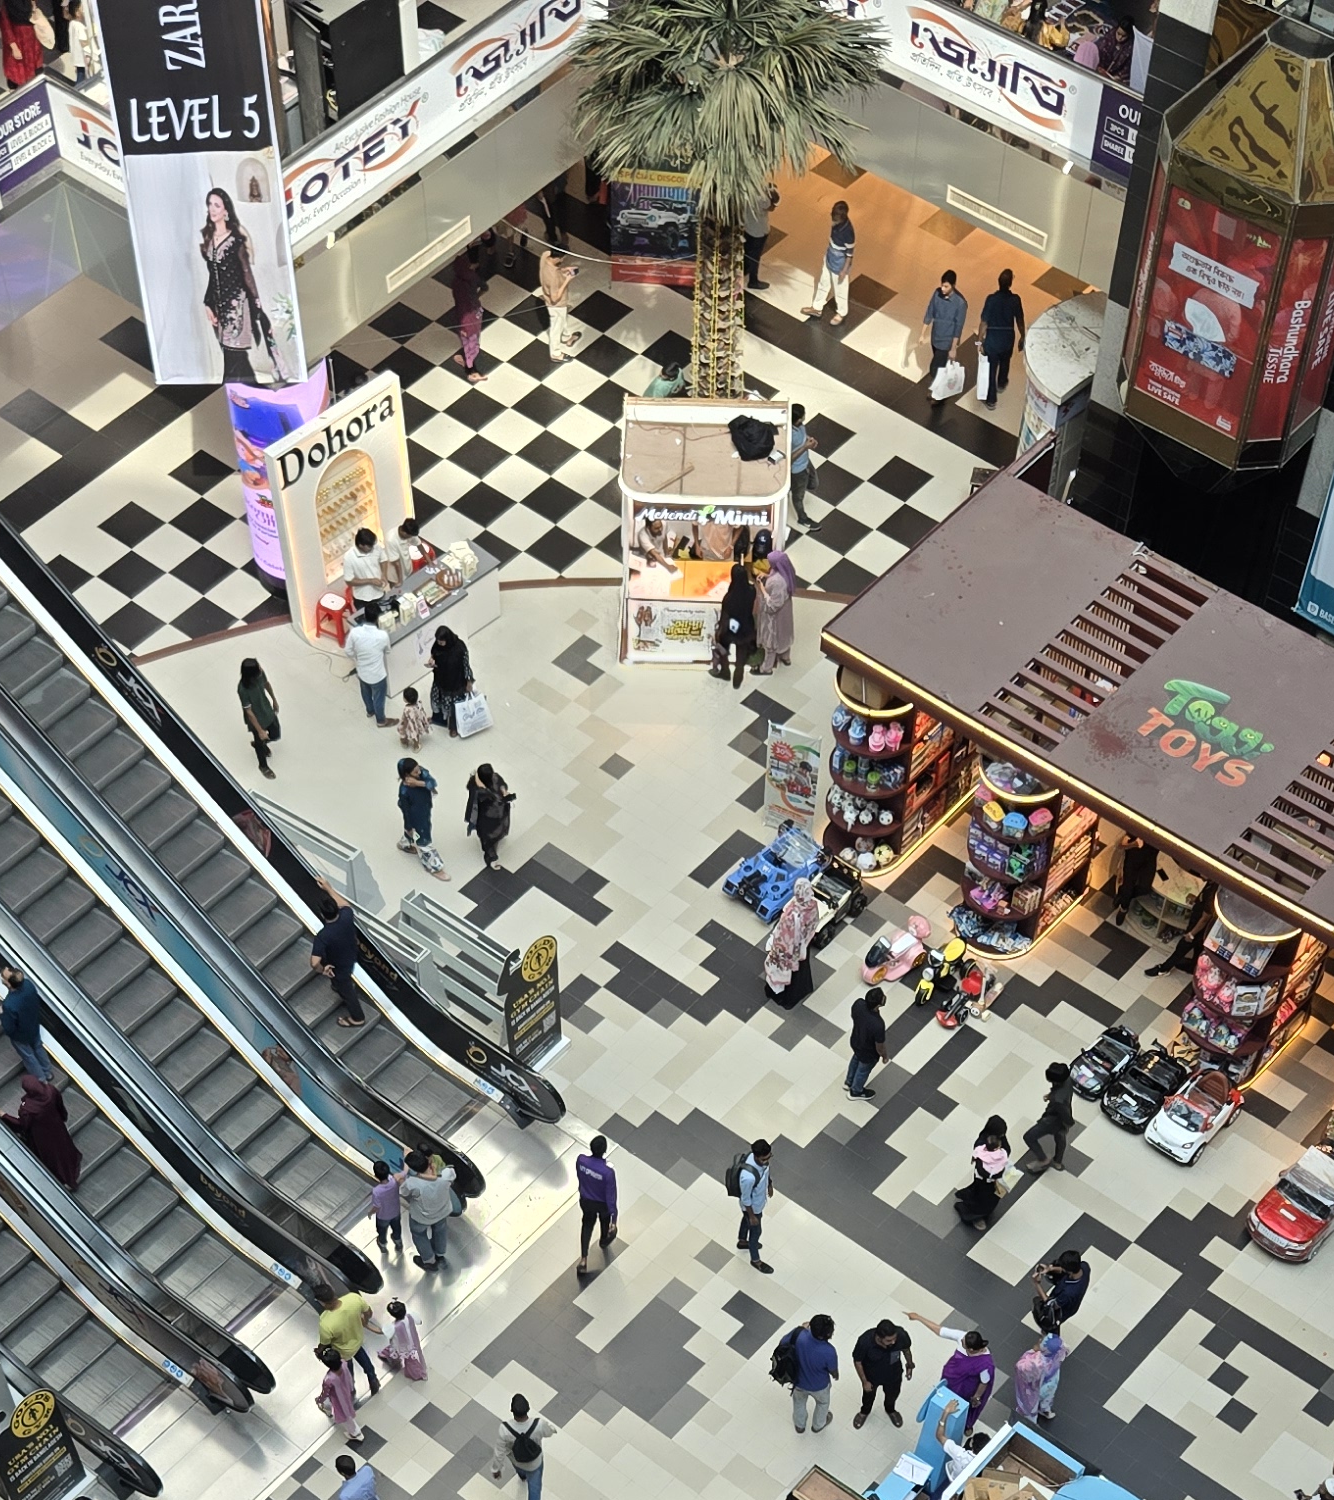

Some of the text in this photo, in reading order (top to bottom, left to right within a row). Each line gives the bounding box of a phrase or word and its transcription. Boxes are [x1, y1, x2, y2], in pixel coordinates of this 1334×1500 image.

[910, 21, 1067, 117] জ্যোতি
[15, 101, 42, 132] STORE
[130, 94, 260, 142] LEVEL 5
[331, 178, 362, 204] Occasion
[1277, 299, 1311, 384] Bashundhara
[1148, 383, 1164, 397] LIVE
[1164, 390, 1181, 405] SAFE
[277, 394, 396, 491] Dohora
[636, 508, 769, 526] Mehendi Mimi
[1137, 707, 1255, 787] TOYS
[511, 1002, 529, 1019] GYM
[529, 978, 554, 1003] CHAIN
[7, 1456, 28, 1476] GYM
[29, 1426, 60, 1456] CHAIN
[8, 1441, 34, 1466] USA'S
